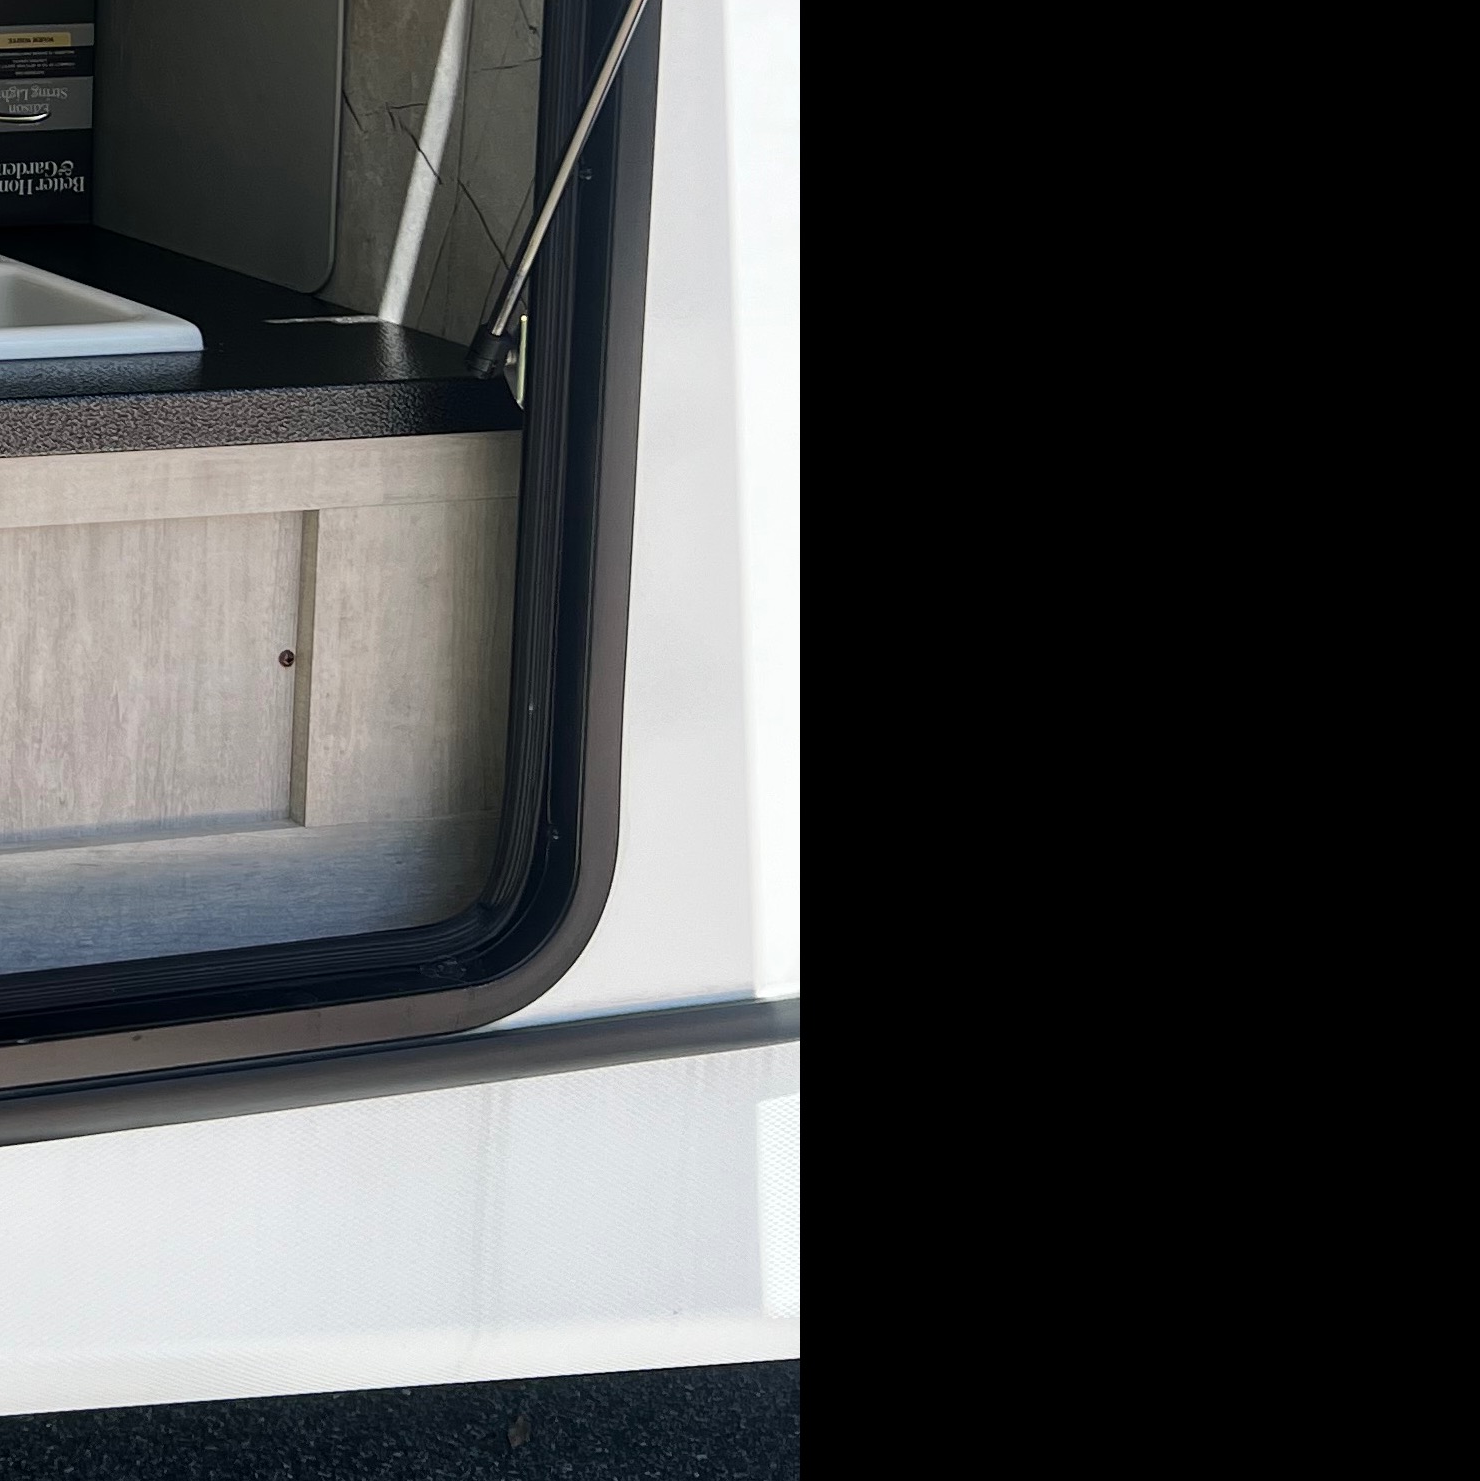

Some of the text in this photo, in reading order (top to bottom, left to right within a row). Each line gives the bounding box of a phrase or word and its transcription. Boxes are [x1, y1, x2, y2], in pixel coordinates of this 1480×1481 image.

[30, 85, 68, 101] String
[8, 103, 49, 114] Edison
[35, 176, 85, 193] Better
